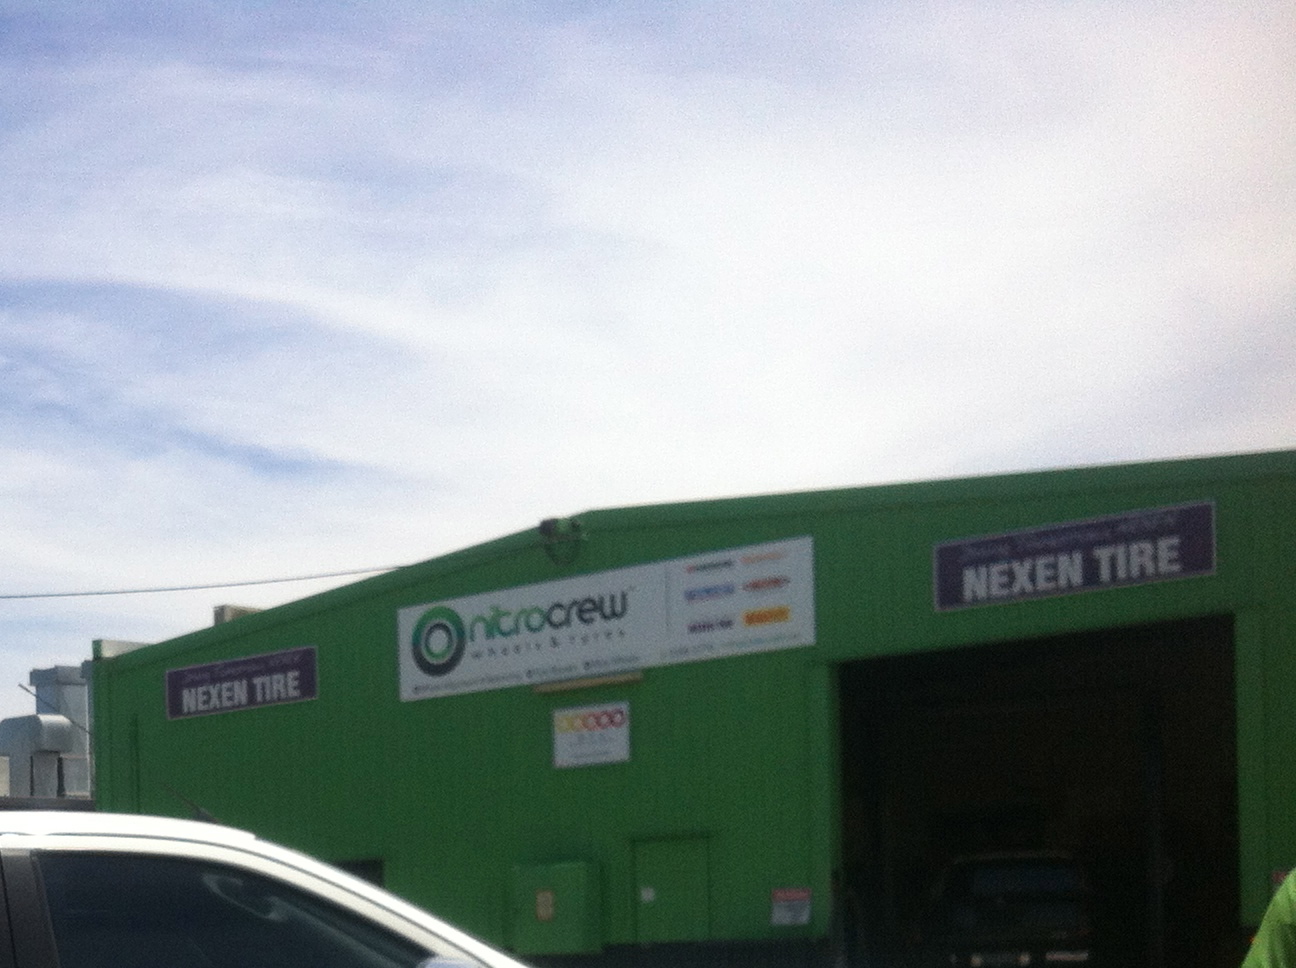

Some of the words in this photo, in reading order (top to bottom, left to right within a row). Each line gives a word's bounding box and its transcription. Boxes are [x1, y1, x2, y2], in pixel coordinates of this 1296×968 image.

[962, 551, 1083, 600] NEXEN
[1092, 535, 1181, 583] TIRE
[469, 591, 627, 642] nitrocrew
[182, 679, 248, 714] NEXEN
[252, 670, 300, 702] TIRE
